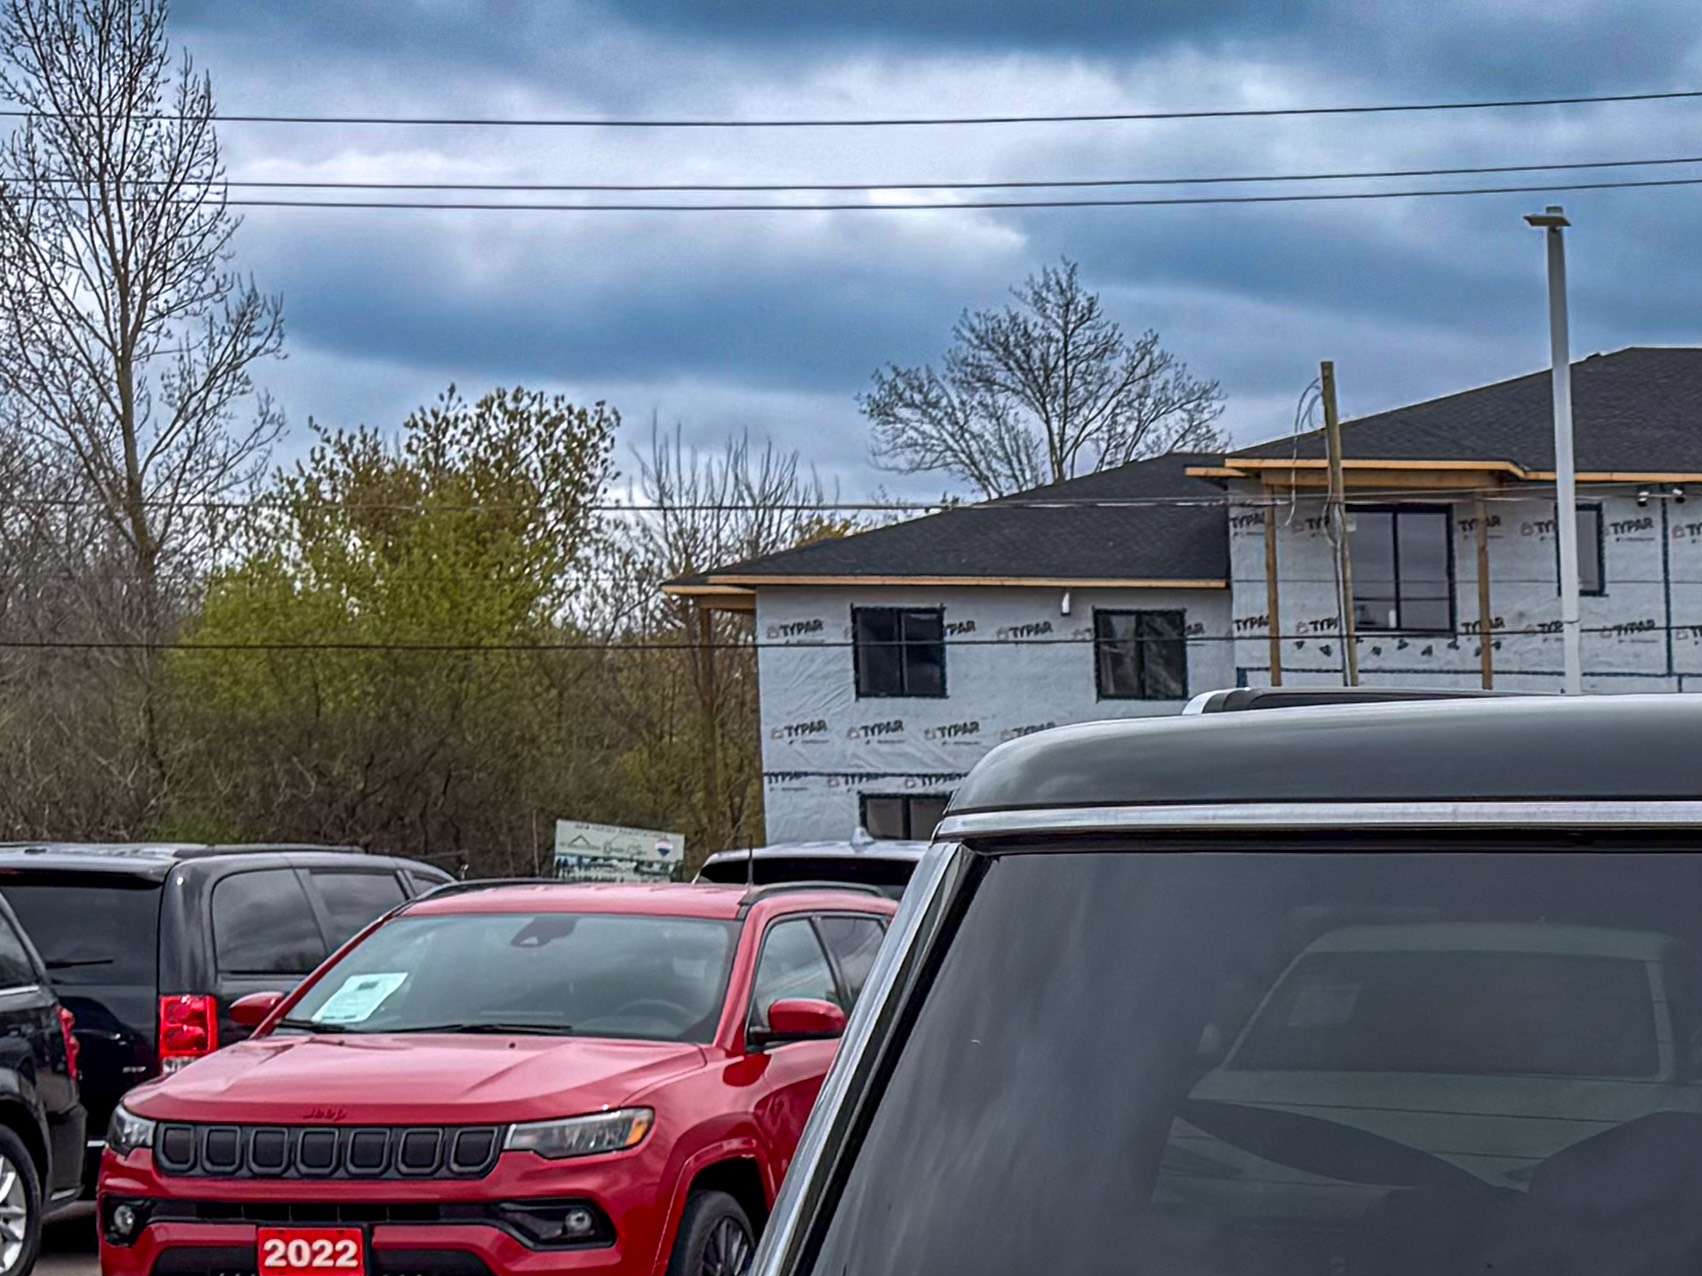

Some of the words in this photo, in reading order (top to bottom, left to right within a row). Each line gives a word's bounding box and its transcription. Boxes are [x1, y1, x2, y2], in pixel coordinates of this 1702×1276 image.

[1610, 518, 1654, 533] TYPAR
[780, 619, 823, 638] TYPAR
[1008, 621, 1052, 639] TYPAR
[1613, 619, 1656, 636] TYPAR
[784, 719, 827, 738] TYPAR
[861, 719, 904, 738] TYPAR
[936, 721, 980, 739] TYPAR
[263, 1238, 358, 1268] 2022
